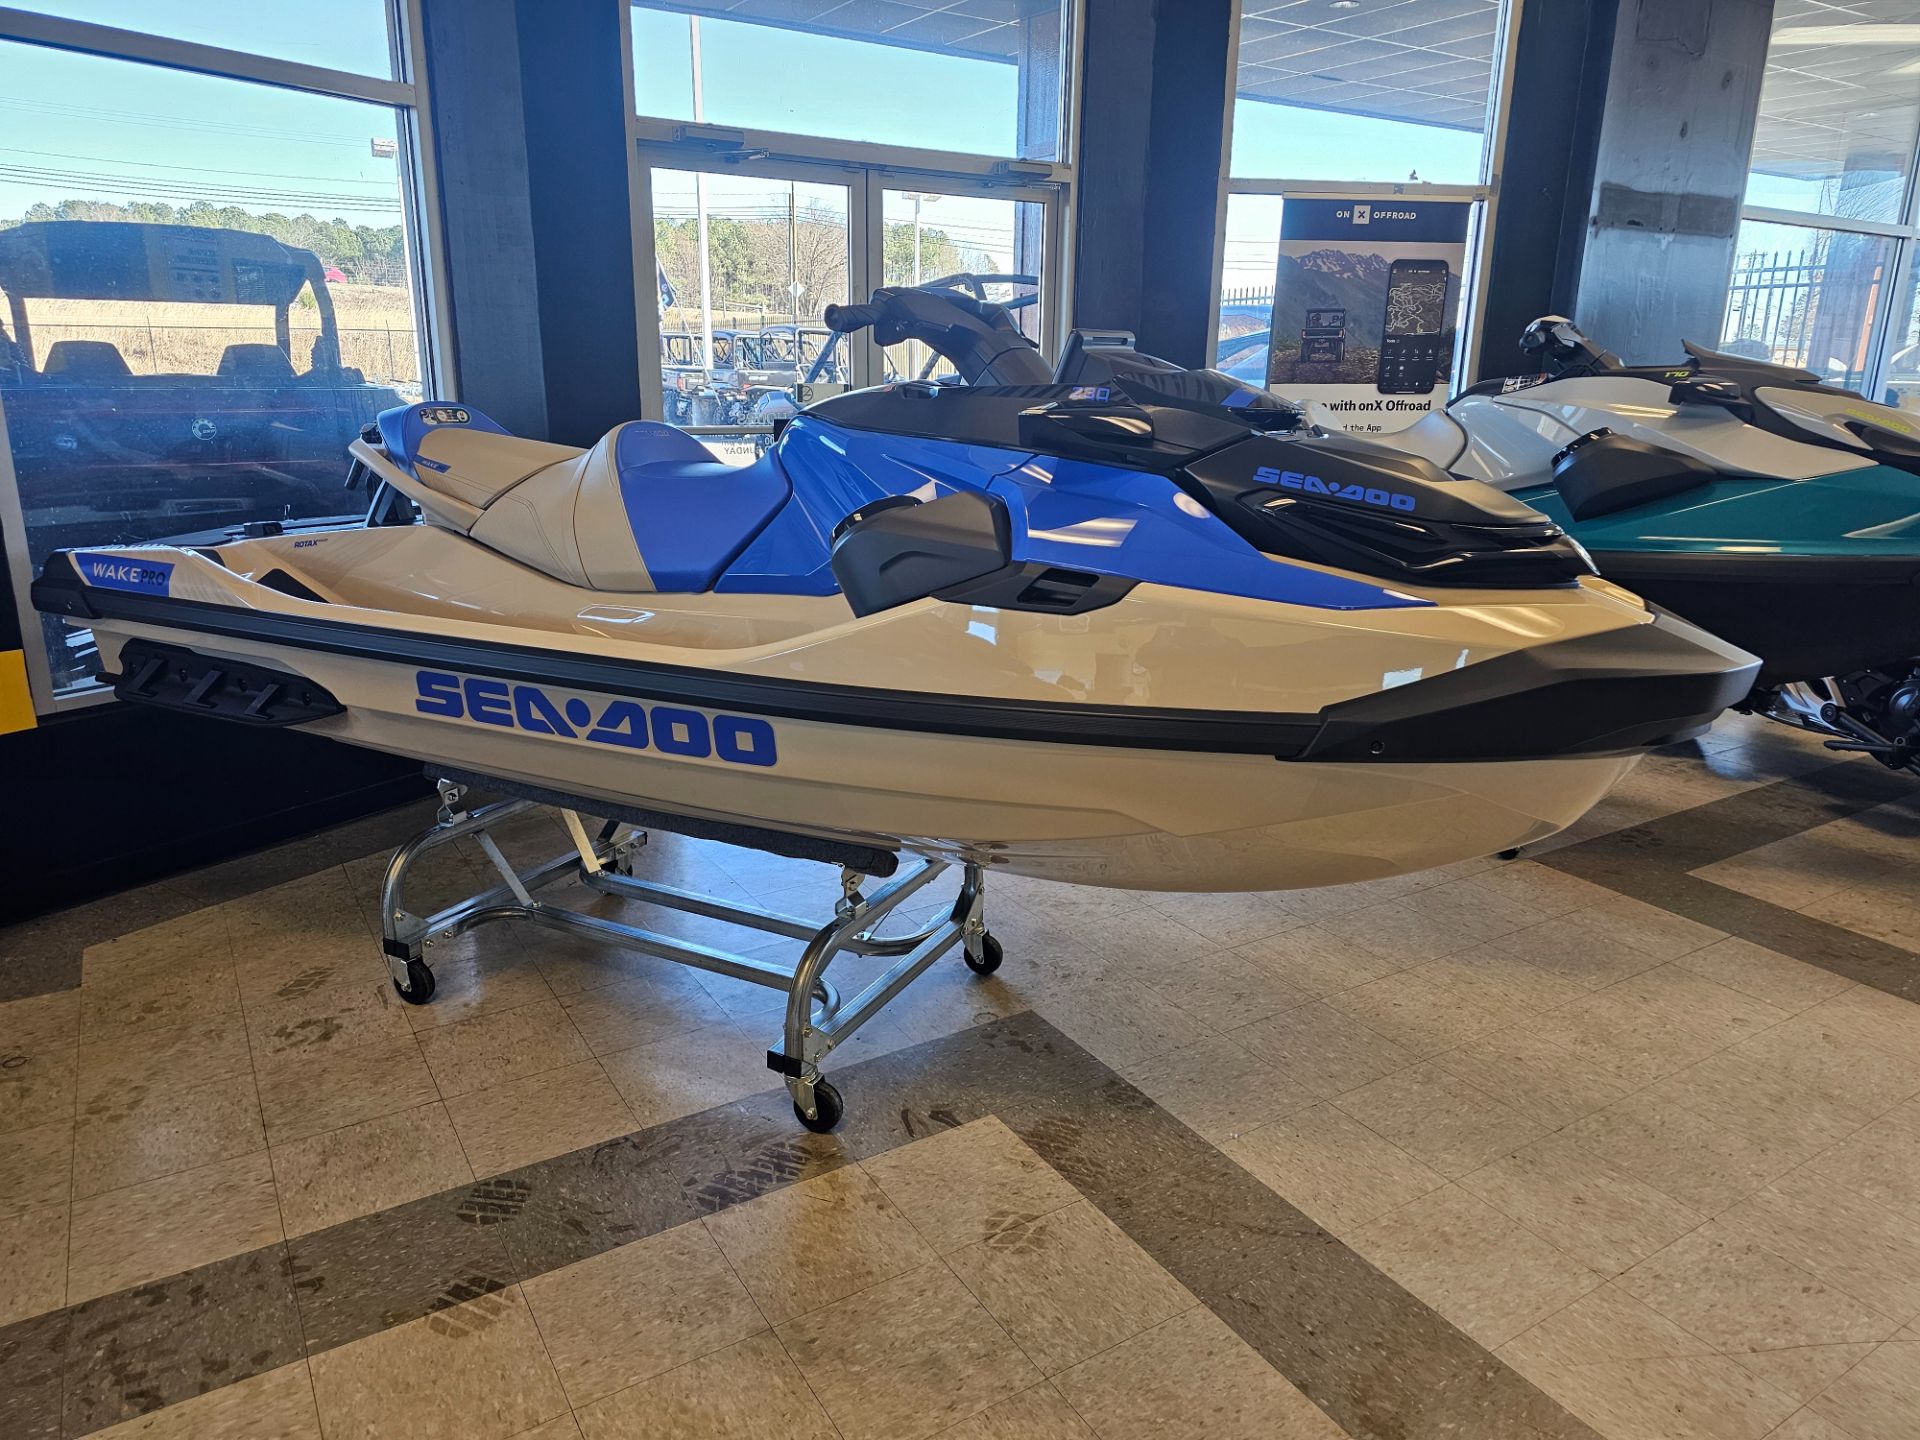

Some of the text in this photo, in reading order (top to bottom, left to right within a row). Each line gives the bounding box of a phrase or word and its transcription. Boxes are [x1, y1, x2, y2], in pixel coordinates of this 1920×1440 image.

[1336, 210, 1350, 219] ON
[1373, 211, 1417, 220] OFFROAD
[1329, 399, 1357, 412] with
[1358, 400, 1383, 412] onX
[1385, 400, 1432, 411] Offroad
[1350, 424, 1364, 432] the
[1366, 424, 1382, 432] App
[294, 540, 318, 548] ROTAX
